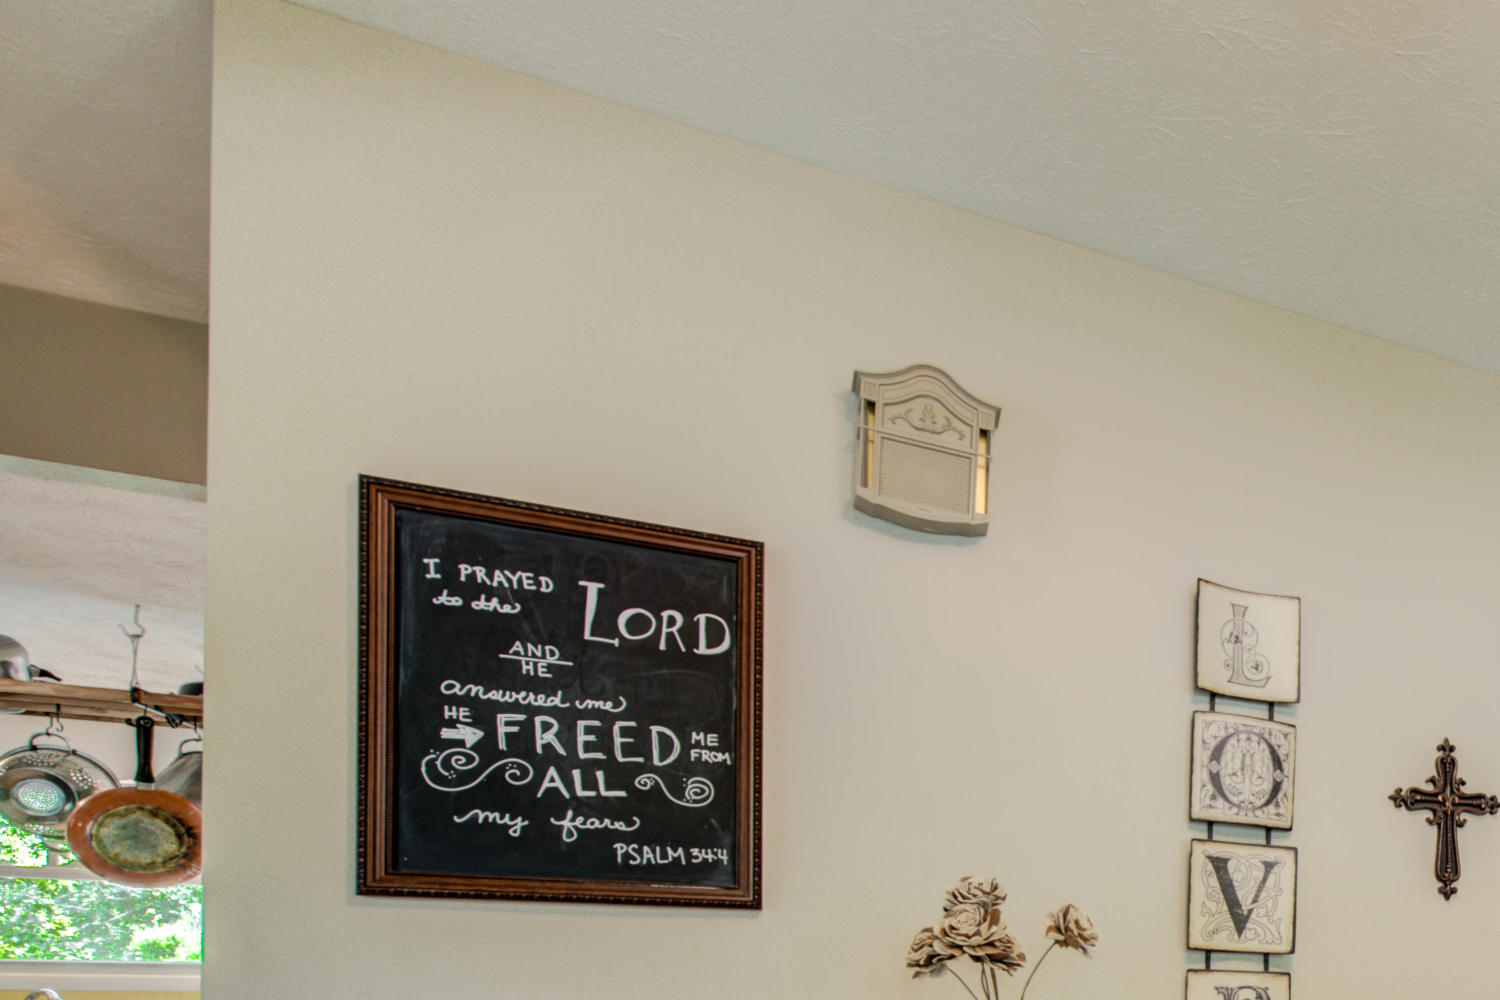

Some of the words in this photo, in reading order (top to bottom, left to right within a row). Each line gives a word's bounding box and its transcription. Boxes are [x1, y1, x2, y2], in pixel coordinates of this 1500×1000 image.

[422, 557, 442, 579] I
[458, 563, 554, 593] PRAYED
[432, 589, 463, 607] to
[471, 593, 521, 614] the
[578, 580, 731, 656] LORD
[508, 640, 561, 660] AND
[521, 660, 553, 678] HE
[440, 679, 571, 709] answered
[575, 695, 627, 713] me
[443, 705, 473, 722] HE
[496, 712, 680, 766] FREED
[691, 731, 719, 747] ME
[690, 749, 731, 765] FROM
[537, 766, 628, 799] ALL
[453, 808, 529, 837] my
[550, 810, 640, 842] fears
[613, 842, 687, 866] PSALM
[689, 847, 729, 866] 34:4
